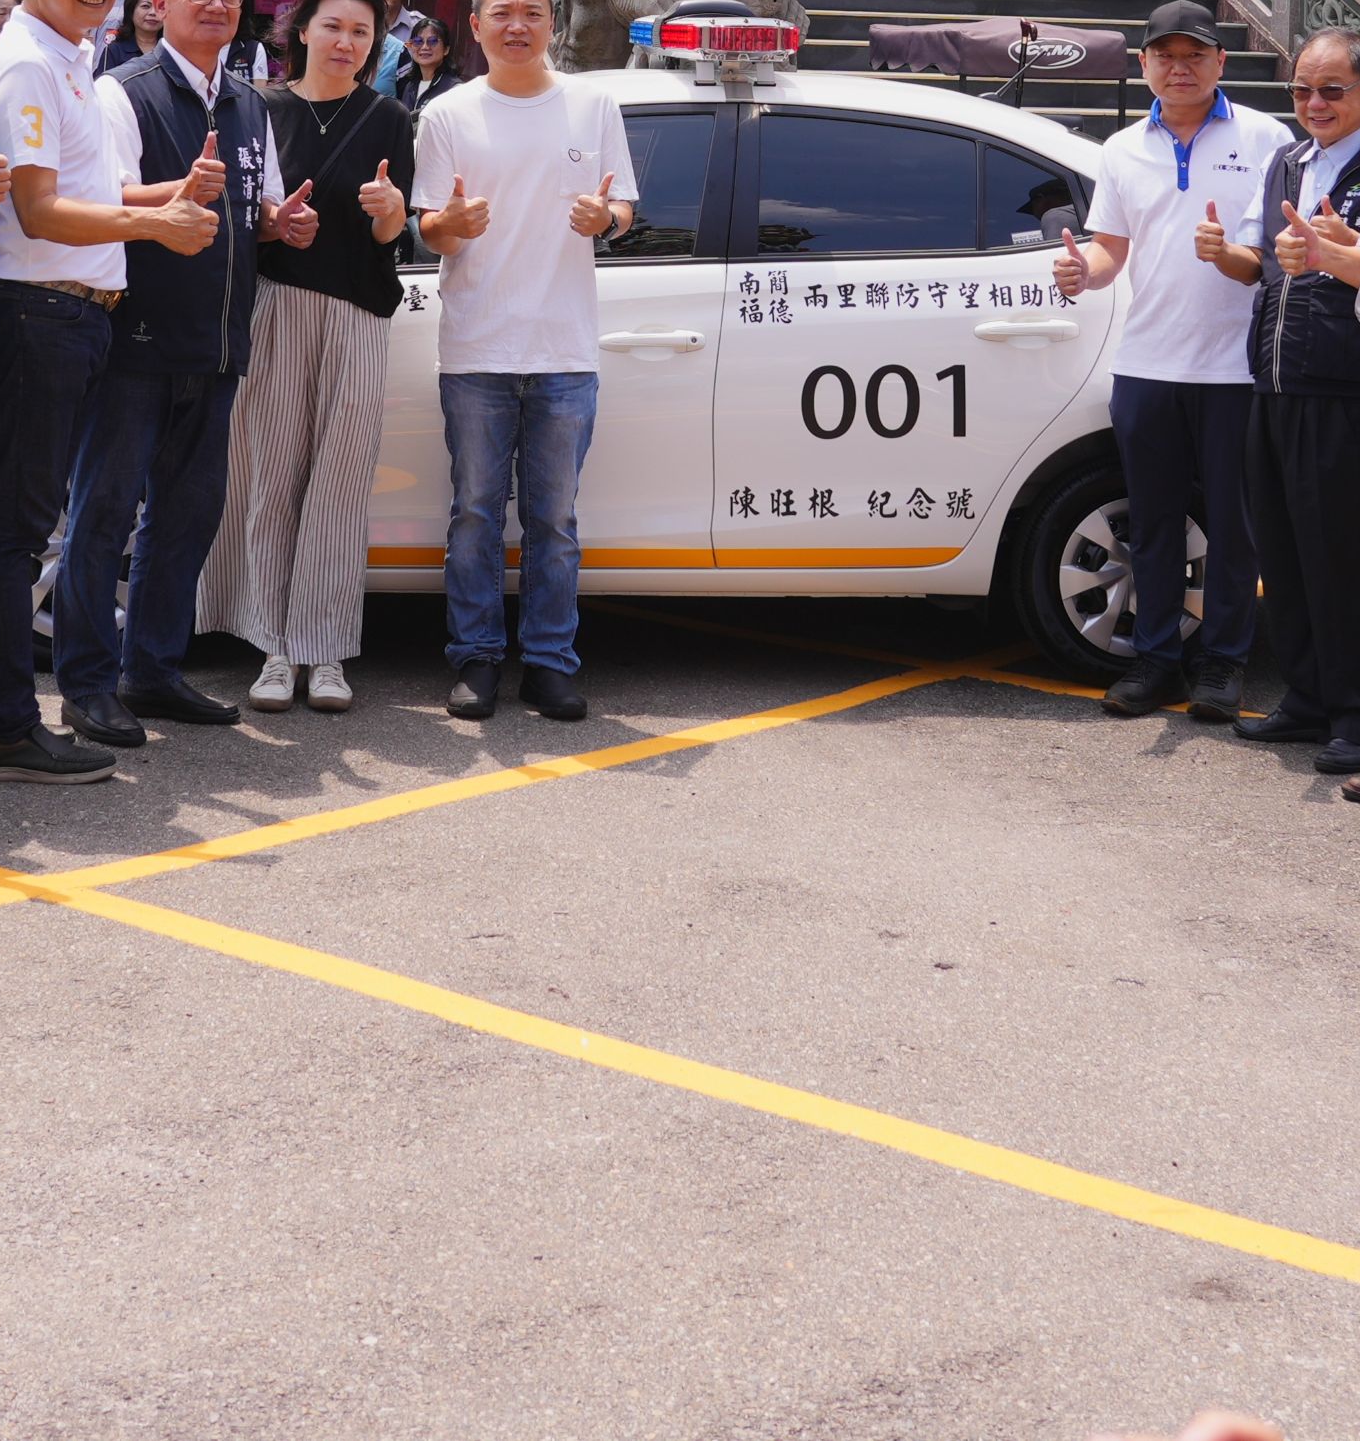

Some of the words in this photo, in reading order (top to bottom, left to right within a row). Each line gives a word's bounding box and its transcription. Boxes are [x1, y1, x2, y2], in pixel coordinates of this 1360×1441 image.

[21, 104, 44, 149] 3
[739, 270, 789, 296] 南簡
[803, 281, 1078, 310] 兩里聯防守望相助隊
[739, 299, 794, 325] 福德
[800, 363, 967, 440] 001
[729, 486, 841, 520] 陳旺根
[866, 486, 976, 520] 紀念號
